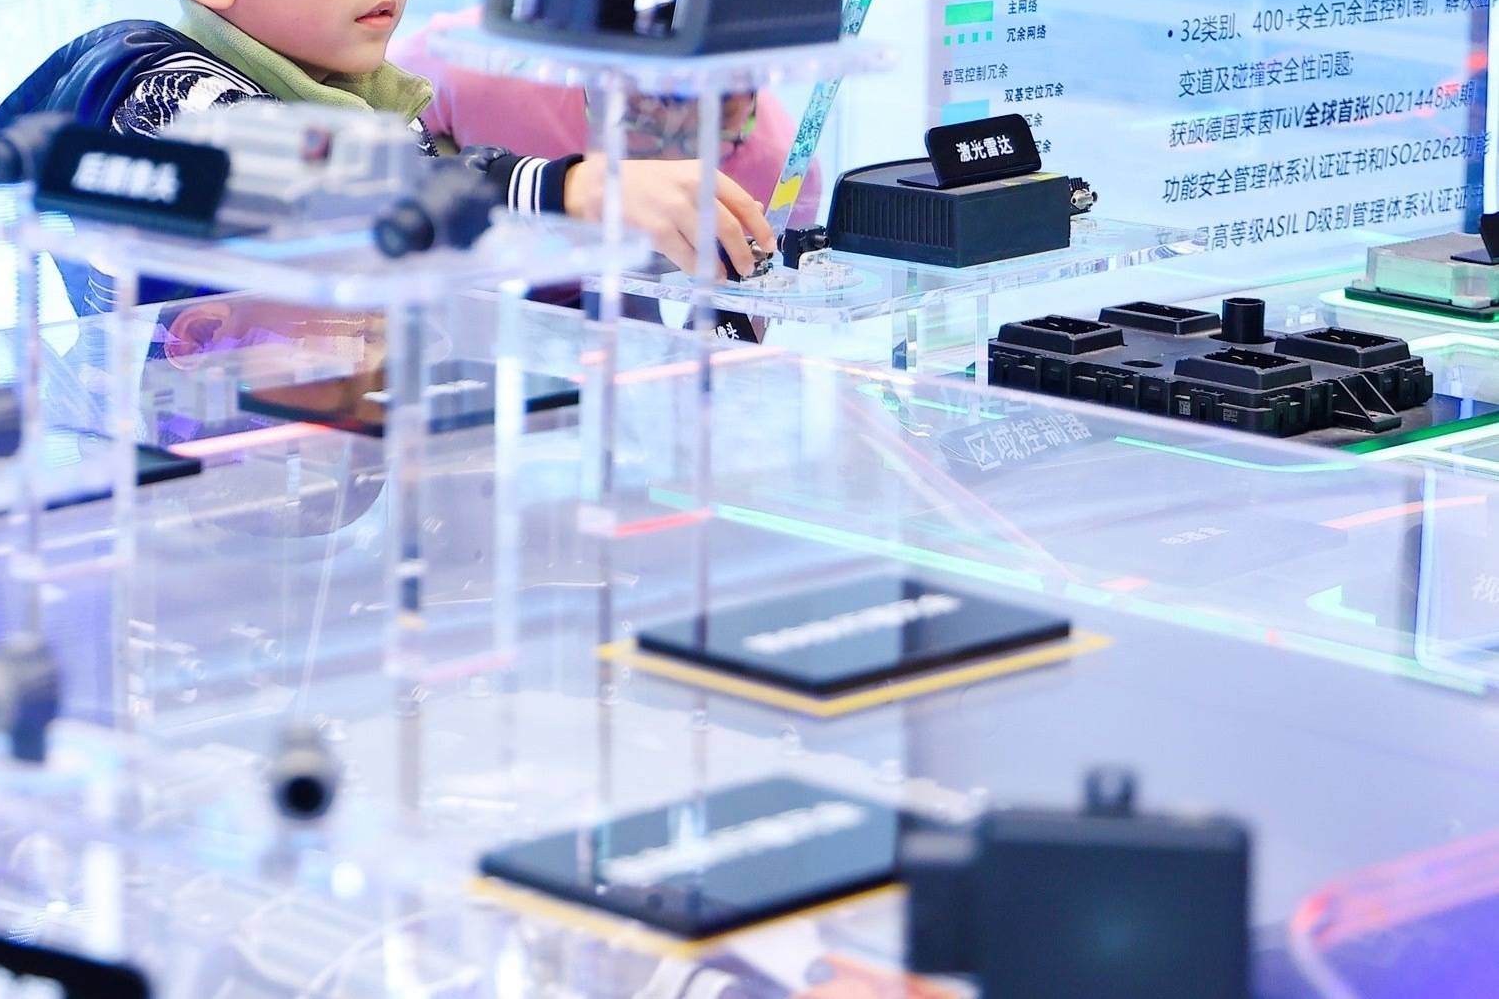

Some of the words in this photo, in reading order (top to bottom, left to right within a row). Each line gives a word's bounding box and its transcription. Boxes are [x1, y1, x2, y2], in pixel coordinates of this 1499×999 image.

[1006, 24, 1047, 43] 冗余网络
[942, 63, 1008, 86] 智驾控制冗余
[1004, 82, 1064, 102] 双基定位冗余
[955, 134, 1014, 163] 激光雷达
[963, 413, 1092, 472] 区域控制器
